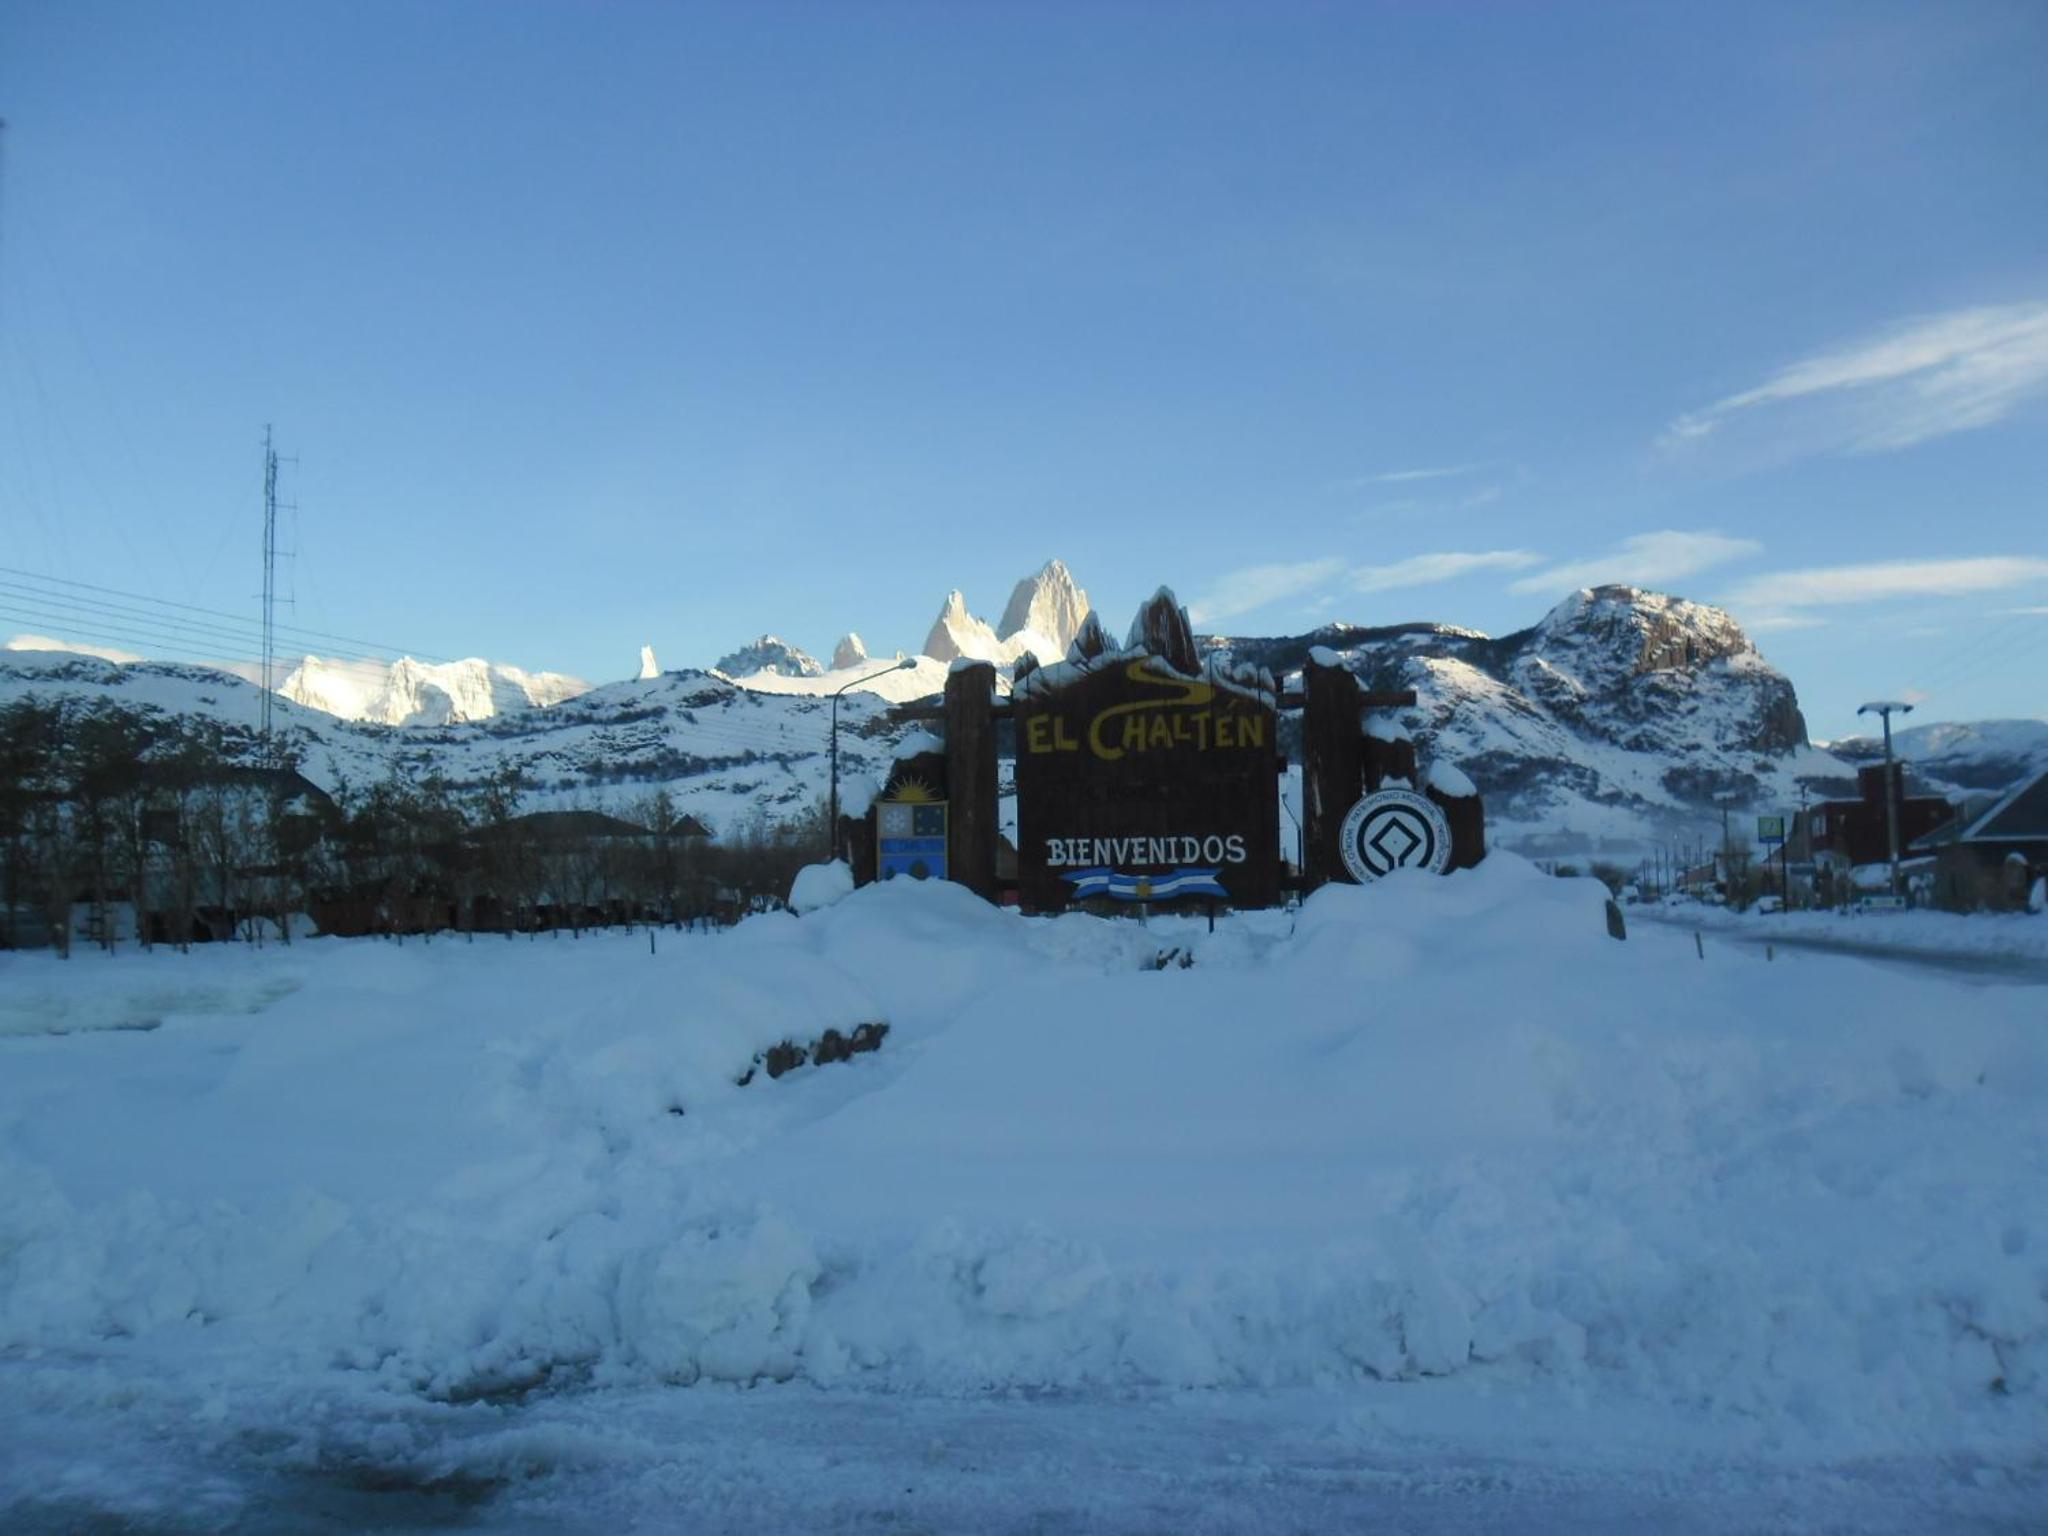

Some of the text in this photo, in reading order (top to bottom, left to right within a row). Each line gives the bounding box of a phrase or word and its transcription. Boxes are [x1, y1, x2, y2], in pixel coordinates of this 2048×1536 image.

[1026, 698, 1264, 760] EL CHALTÉN
[1046, 834, 1247, 866] BIENVENIDOS
